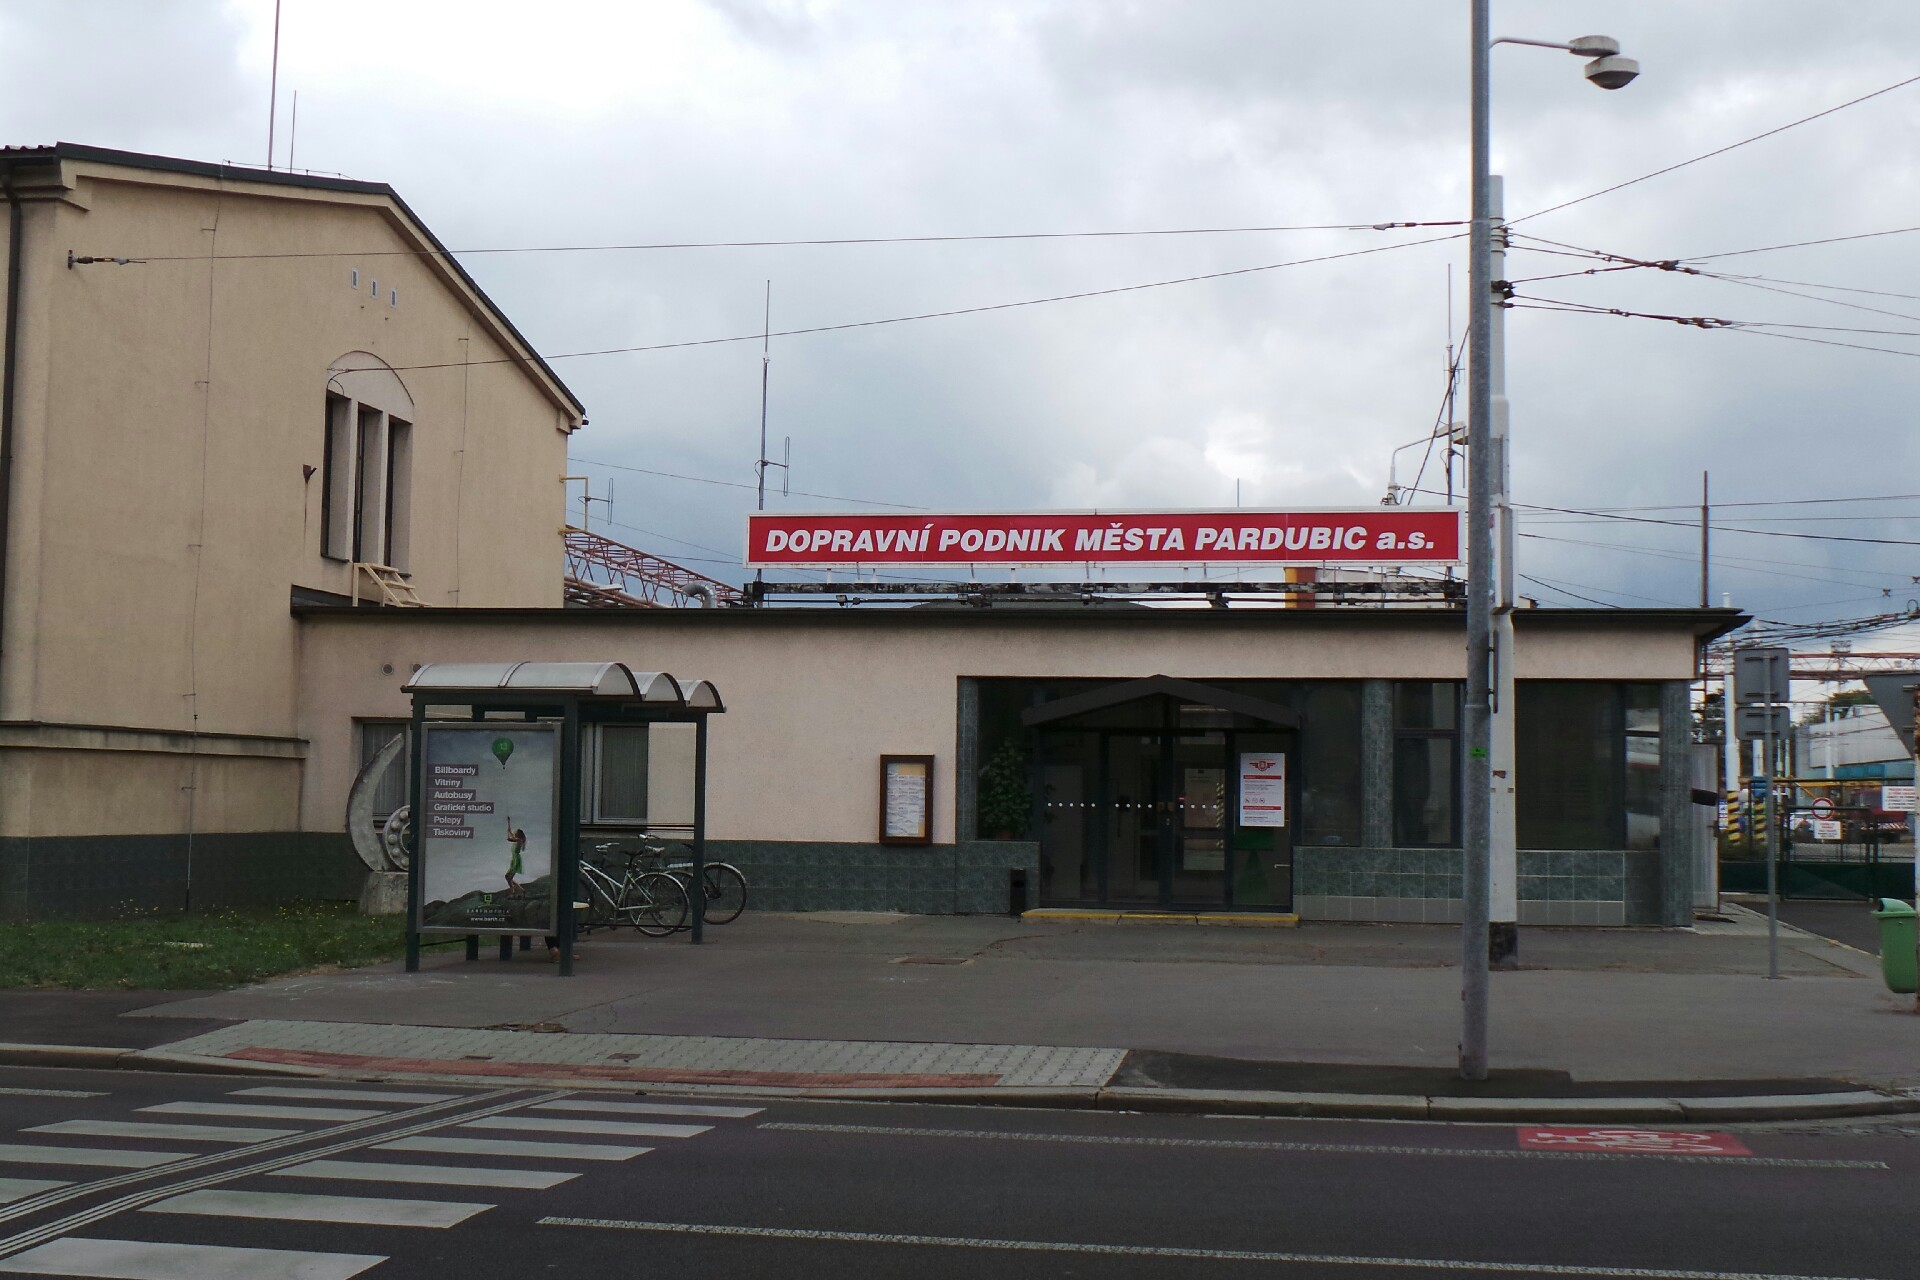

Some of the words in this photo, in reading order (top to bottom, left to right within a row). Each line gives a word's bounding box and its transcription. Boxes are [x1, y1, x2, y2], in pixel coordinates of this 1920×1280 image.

[766, 523, 934, 552] DOPRAVNÍ
[939, 528, 1067, 552] PODNIK
[1075, 522, 1185, 552] MĚSTA
[1195, 526, 1368, 551] PARDUBIC
[1377, 531, 1434, 550] a.s.
[434, 766, 476, 775] Billboardy
[434, 791, 473, 800] Autobusy
[433, 803, 466, 811] Grafické
[433, 815, 461, 825] Polepy
[433, 828, 471, 838] Tiskoviny
